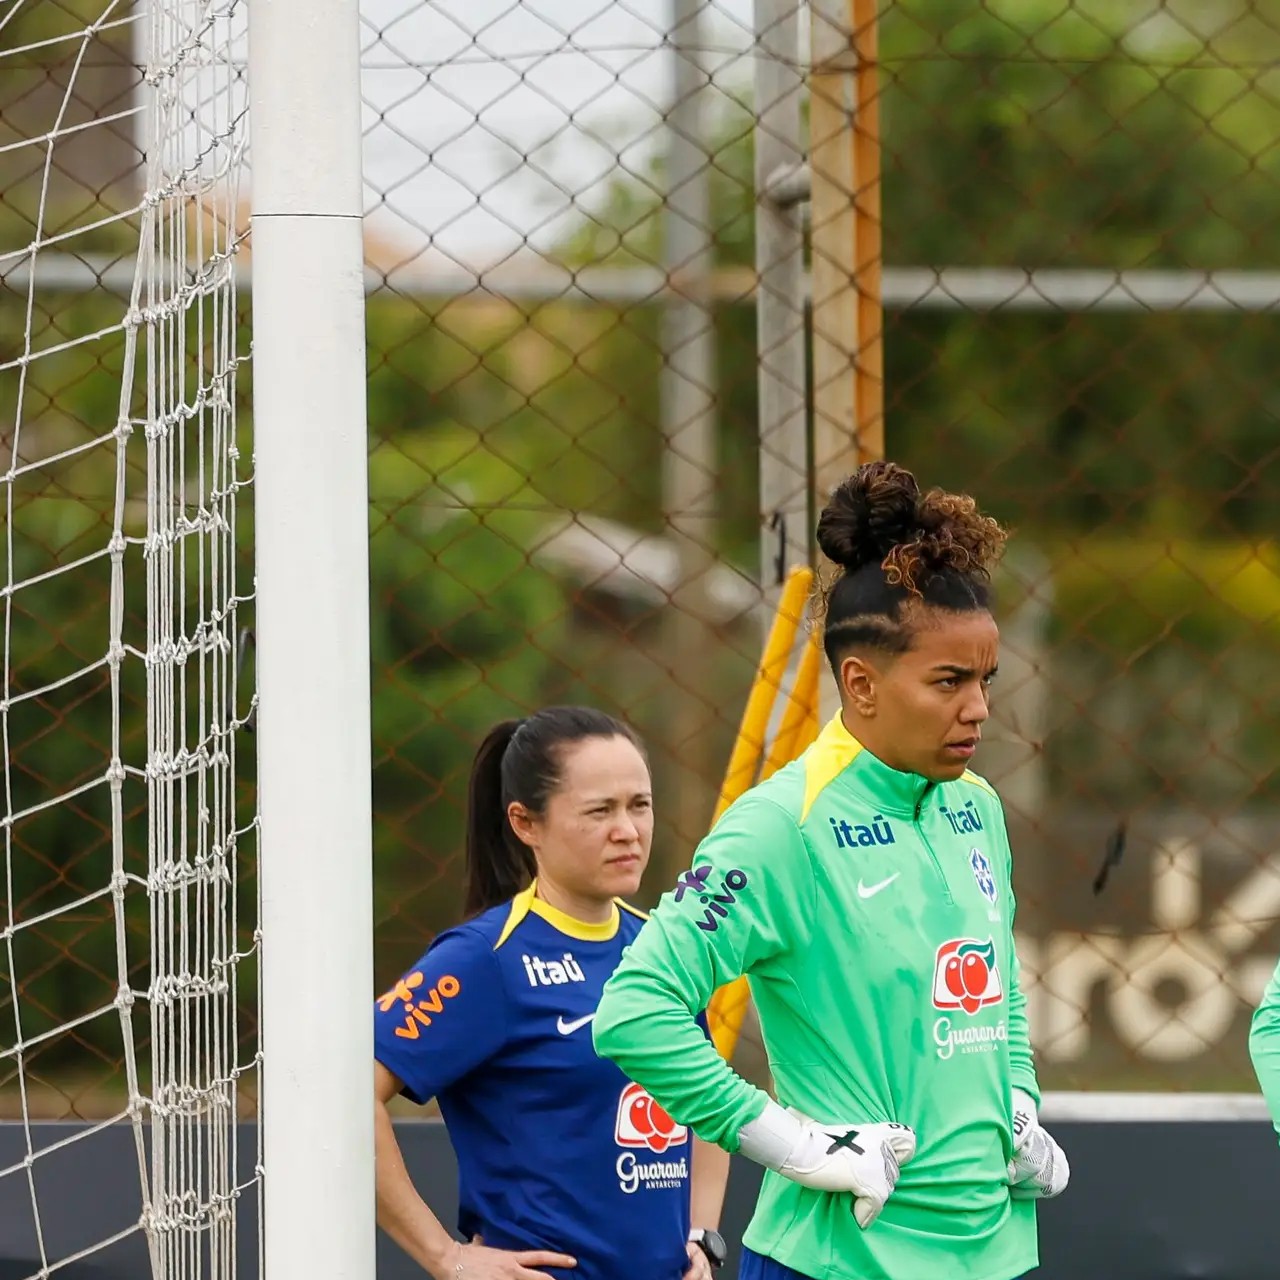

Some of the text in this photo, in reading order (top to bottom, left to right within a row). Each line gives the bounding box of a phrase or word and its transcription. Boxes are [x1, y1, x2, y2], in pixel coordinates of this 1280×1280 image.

[828, 814, 897, 849] itaú
[695, 868, 748, 932] vivo
[521, 952, 585, 988] itaú
[394, 974, 460, 1040] vivo
